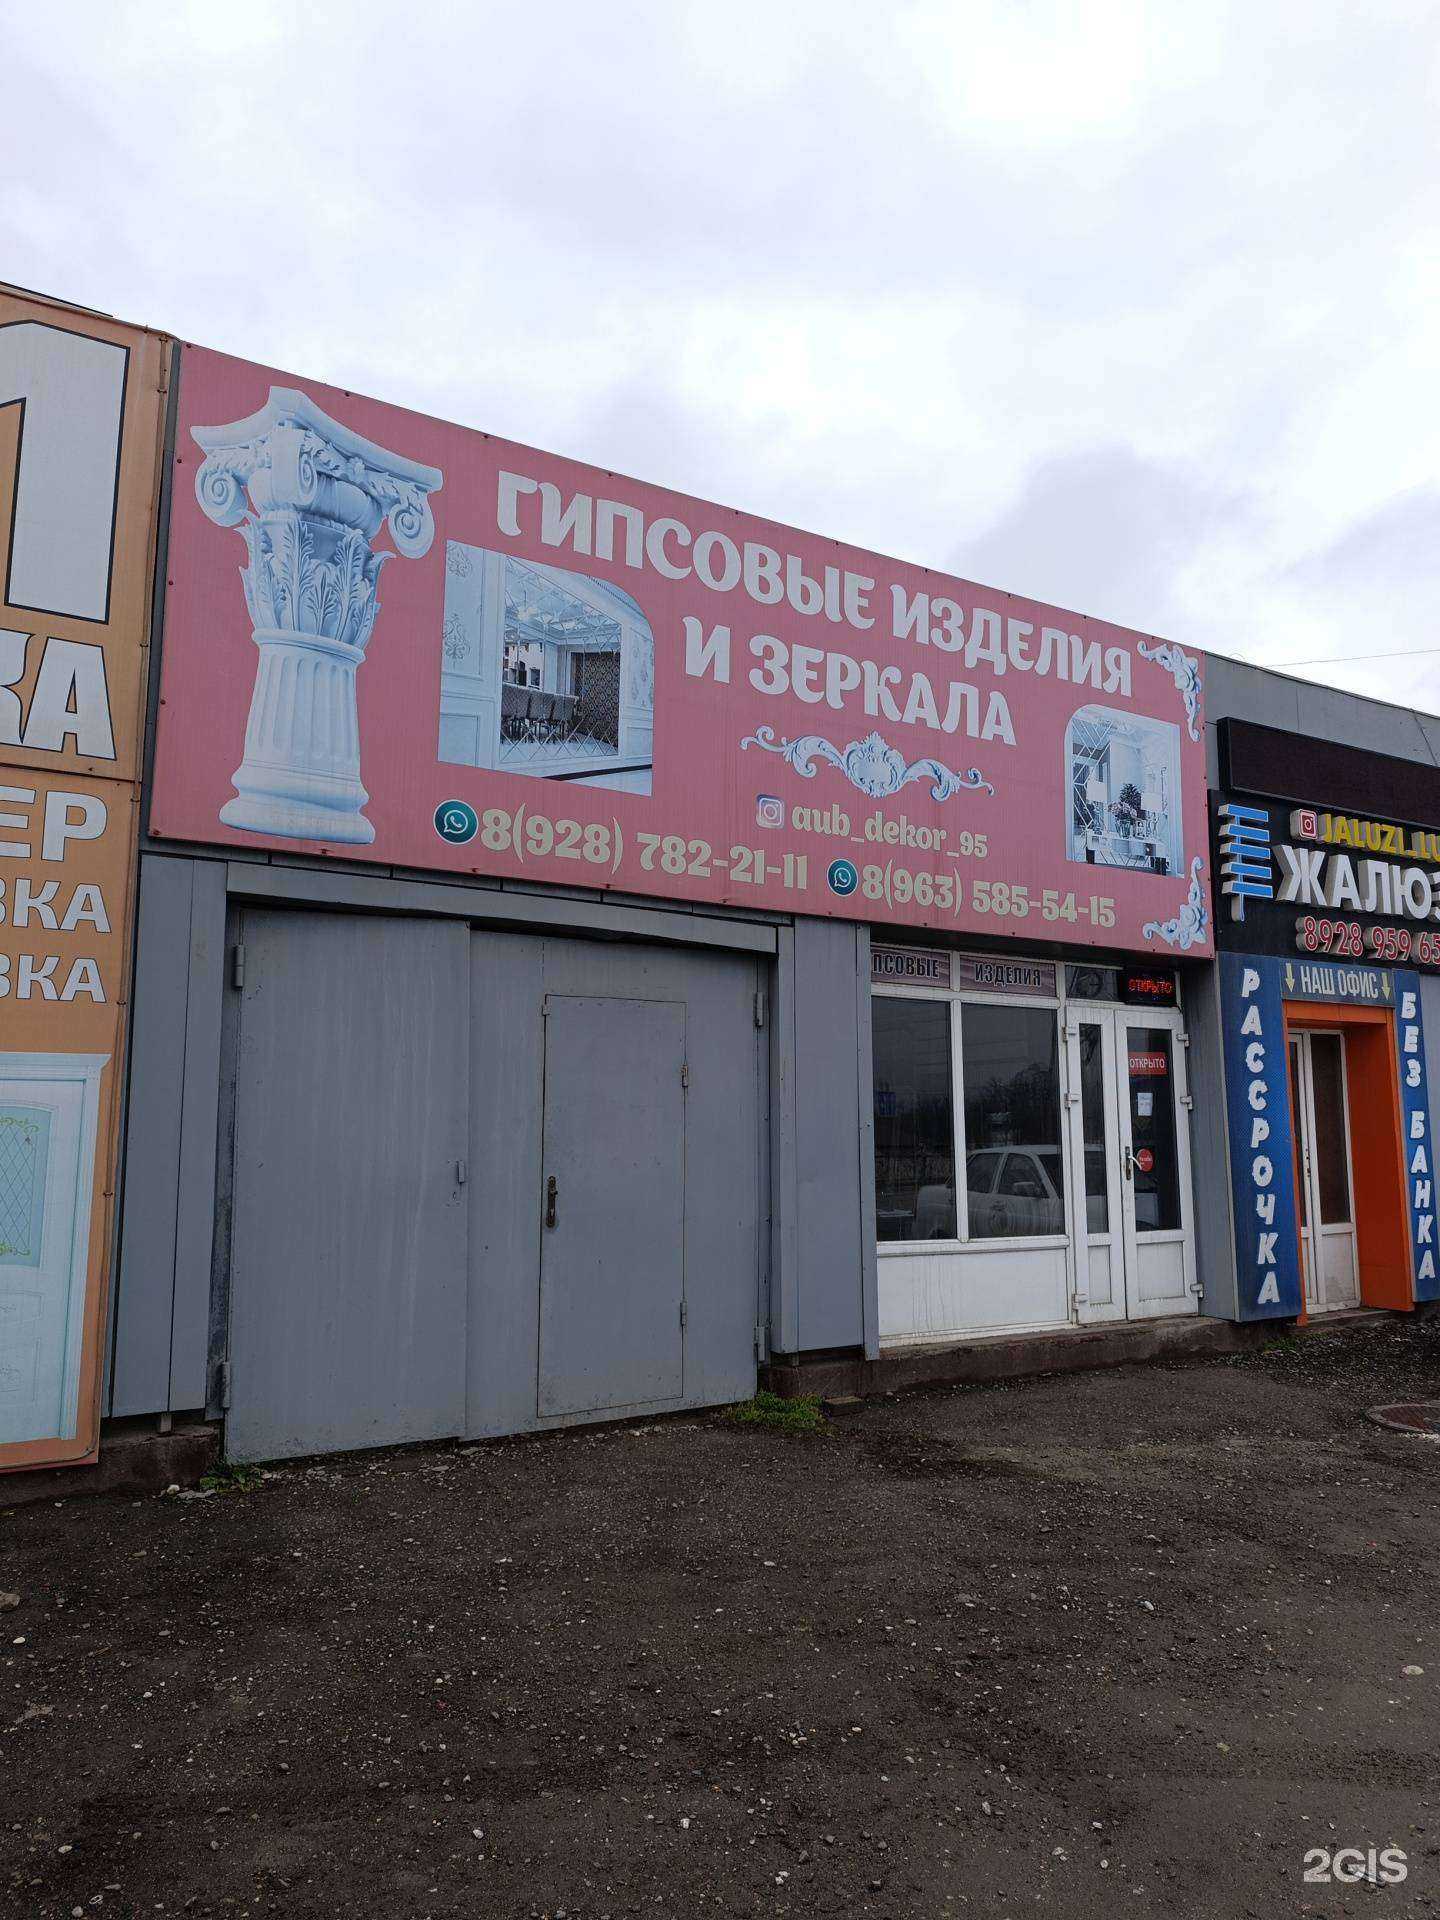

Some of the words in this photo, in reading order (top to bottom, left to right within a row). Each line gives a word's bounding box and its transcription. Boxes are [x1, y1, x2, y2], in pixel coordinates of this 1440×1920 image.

[496, 470, 876, 631] ГИПСОВЫЕ
[889, 583, 1133, 697] ИЗДЕЛИЯ
[682, 615, 731, 684] И
[747, 633, 1017, 747] ЗЕРКАЛА
[480, 802, 624, 876] 8(928)
[635, 832, 808, 890] 782-21-11
[790, 802, 989, 859] aub_dekor_95
[0, 876, 112, 933] КА
[861, 858, 963, 918] 8(963)
[971, 880, 1116, 928] 585-54-15
[1300, 915, 1365, 957] 8928
[1370, 926, 1412, 961] 959
[0, 953, 107, 1003] КА
[974, 961, 1042, 987] ИЗДЕЛИЯ
[1127, 977, 1174, 995] ОТКРЫТО
[1300, 965, 1334, 996] НАШ
[1338, 969, 1378, 1000] ОФИС
[1129, 1055, 1166, 1070] ОТКРЫТО
[1402, 991, 1421, 1088] БЕЗ
[1240, 967, 1281, 1305] РАССРОЧКА
[1410, 1110, 1436, 1280] БАНКА
